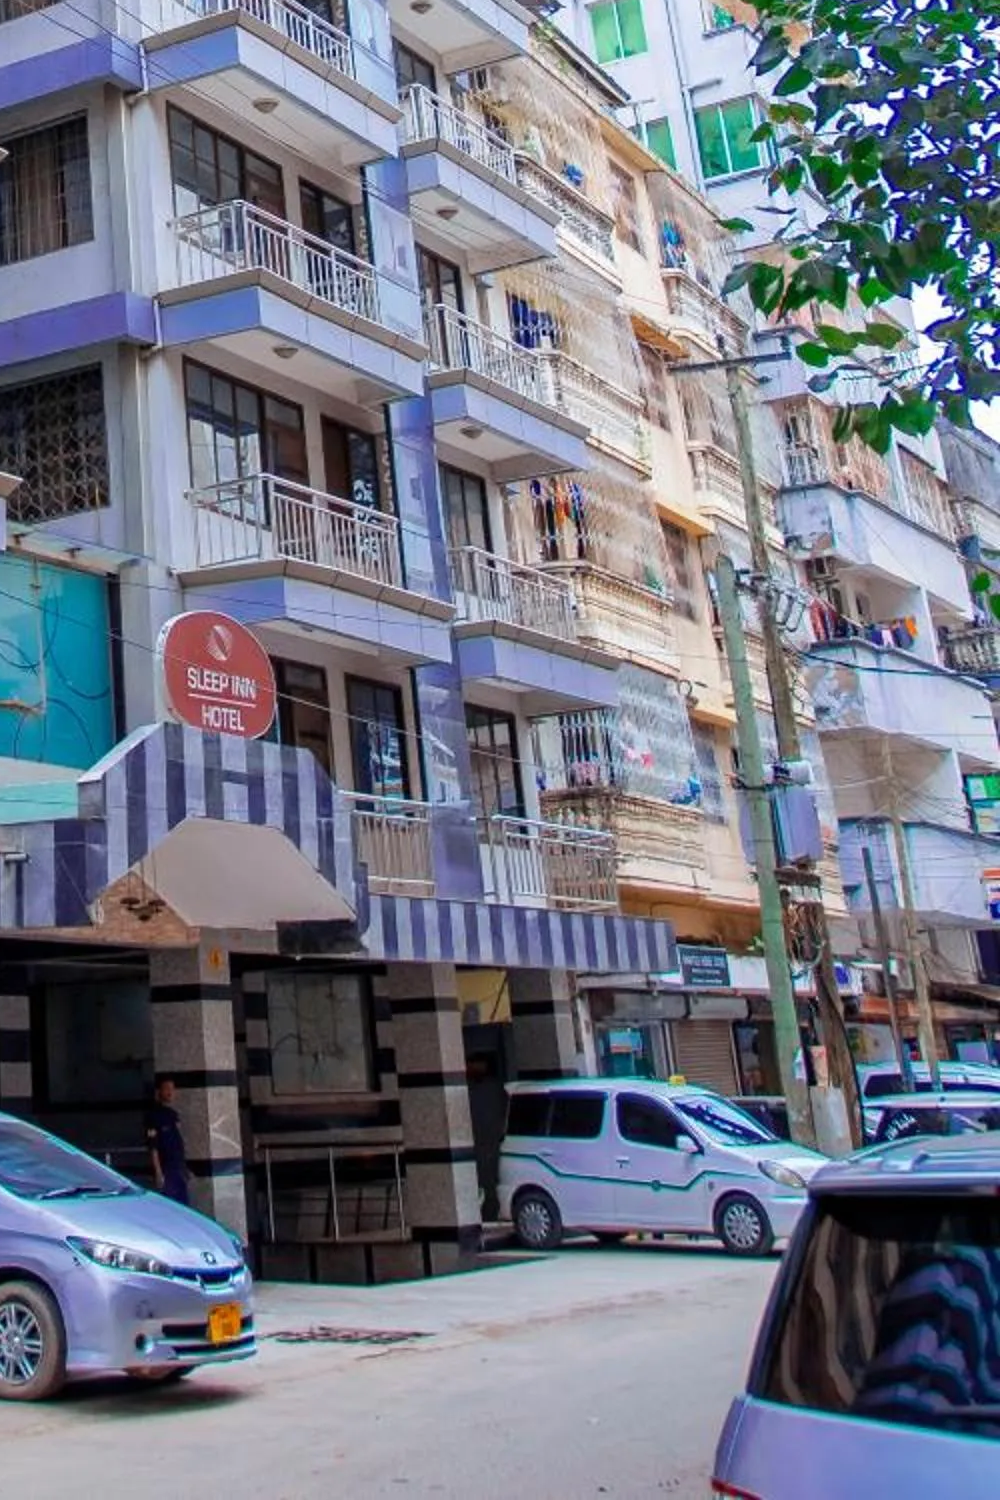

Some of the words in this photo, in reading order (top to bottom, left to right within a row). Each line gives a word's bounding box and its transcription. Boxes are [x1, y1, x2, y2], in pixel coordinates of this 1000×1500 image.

[187, 667, 230, 694] SLEEP
[231, 678, 257, 699] INN
[202, 706, 245, 731] HOTEL
